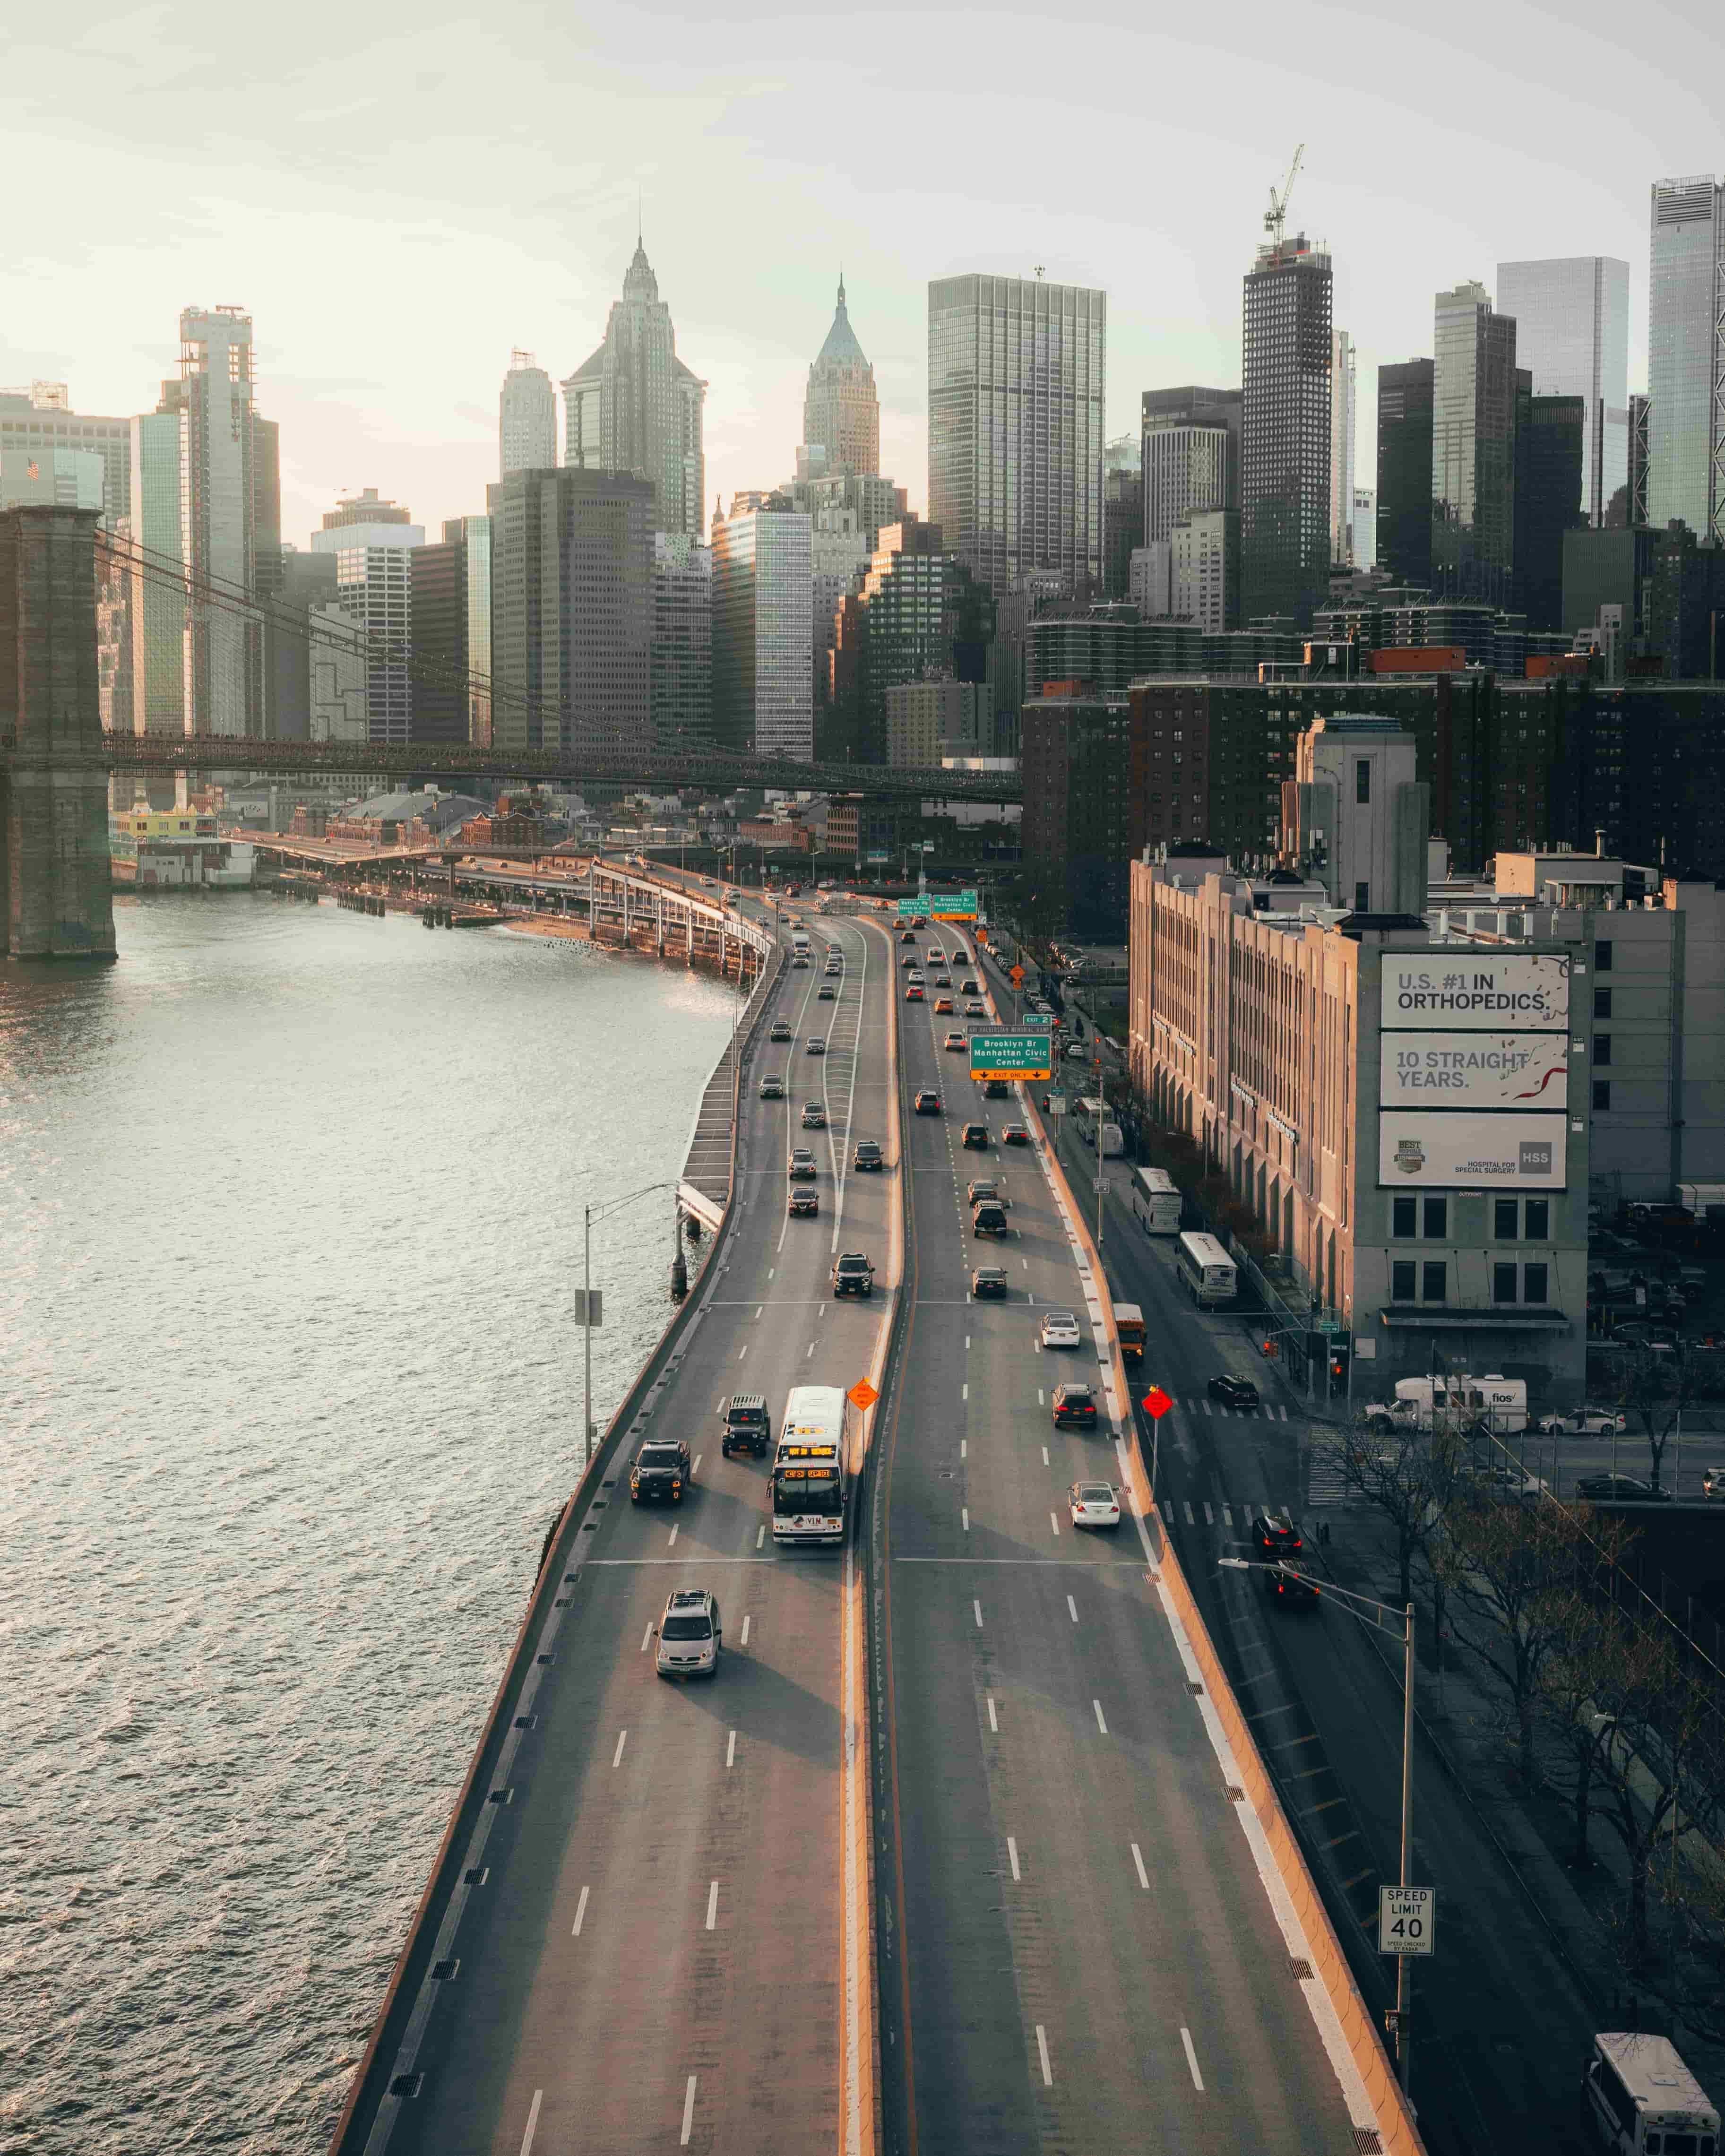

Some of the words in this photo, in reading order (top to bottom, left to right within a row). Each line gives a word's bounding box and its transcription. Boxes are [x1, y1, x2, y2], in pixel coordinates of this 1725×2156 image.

[1397, 974, 1436, 990] U.S.
[1442, 974, 1467, 990] #1
[1474, 974, 1493, 990] IN
[1397, 992, 1551, 1010] ORTHOPEDICS.
[984, 1040, 1023, 1048] Brooklyn
[1397, 1052, 1419, 1068] 10
[1425, 1052, 1529, 1069] STRAIGHT
[1397, 1071, 1470, 1088] YEARS.
[1398, 1140, 1422, 1148] BEST
[1522, 1152, 1549, 1164] HSS
[1492, 1393, 1512, 1402] fios
[1387, 1890, 1427, 1901] SPEED
[1392, 1904, 1422, 1915] LIMIT
[1391, 1918, 1423, 1938] 40
